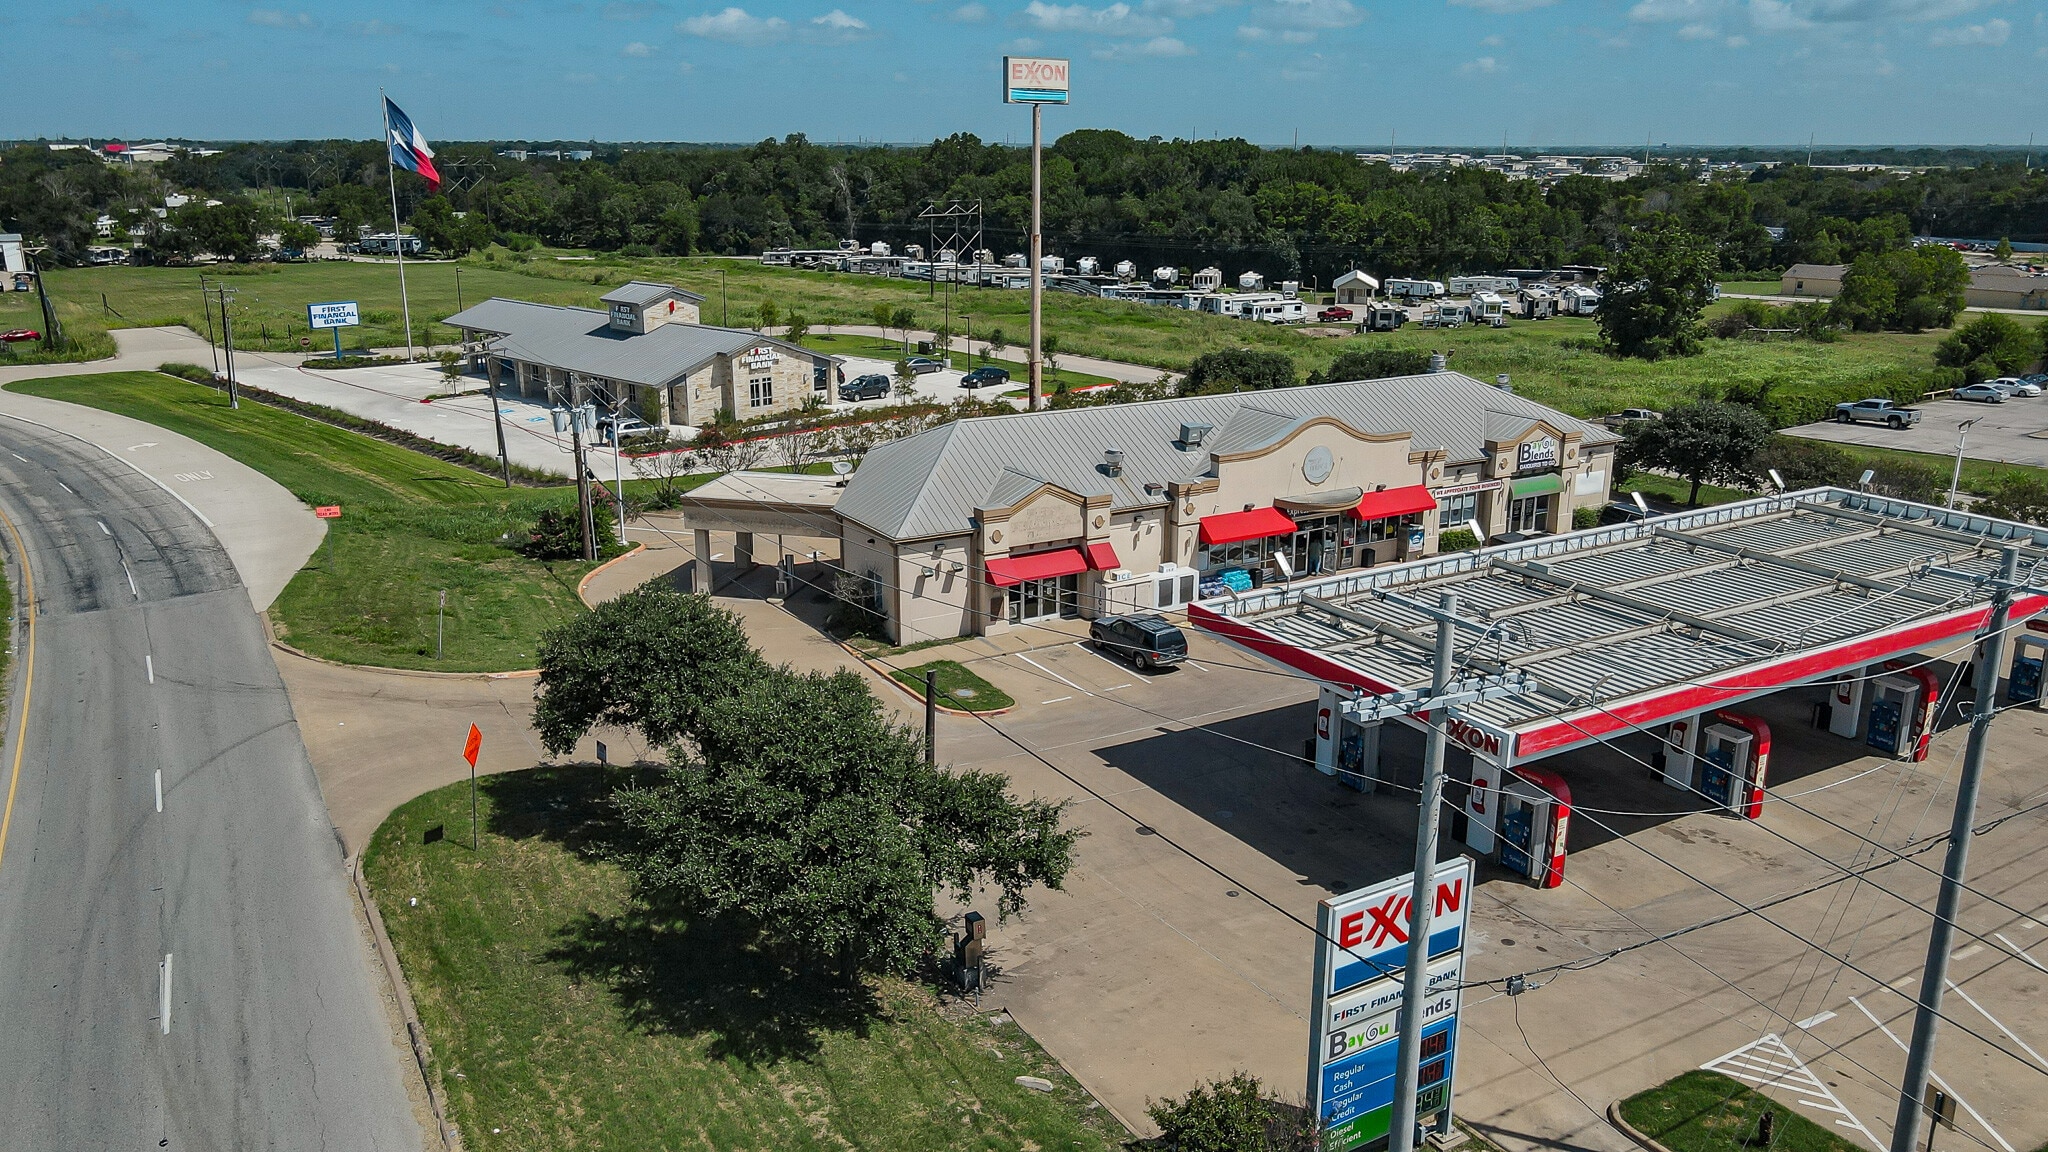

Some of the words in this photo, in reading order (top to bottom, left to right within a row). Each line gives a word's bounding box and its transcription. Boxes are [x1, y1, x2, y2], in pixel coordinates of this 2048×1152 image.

[1012, 61, 1066, 85] EXXON
[313, 311, 356, 319] FINANCIAL
[615, 305, 631, 313] FRST
[741, 352, 780, 364] FINANCIAL
[750, 346, 773, 356] FIRST
[750, 360, 773, 370] BANK
[174, 469, 216, 483] ONLY
[1118, 571, 1131, 580] ICE
[1446, 717, 1502, 756] XXON
[1333, 1003, 1368, 1022] FIRST
[1370, 989, 1404, 1009] FINAN
[1428, 967, 1457, 987] BANK
[1328, 1021, 1389, 1059] Bayou
[1333, 1063, 1365, 1082] Regular
[1333, 1080, 1353, 1094] Cash
[1330, 1121, 1354, 1139] Diesel
